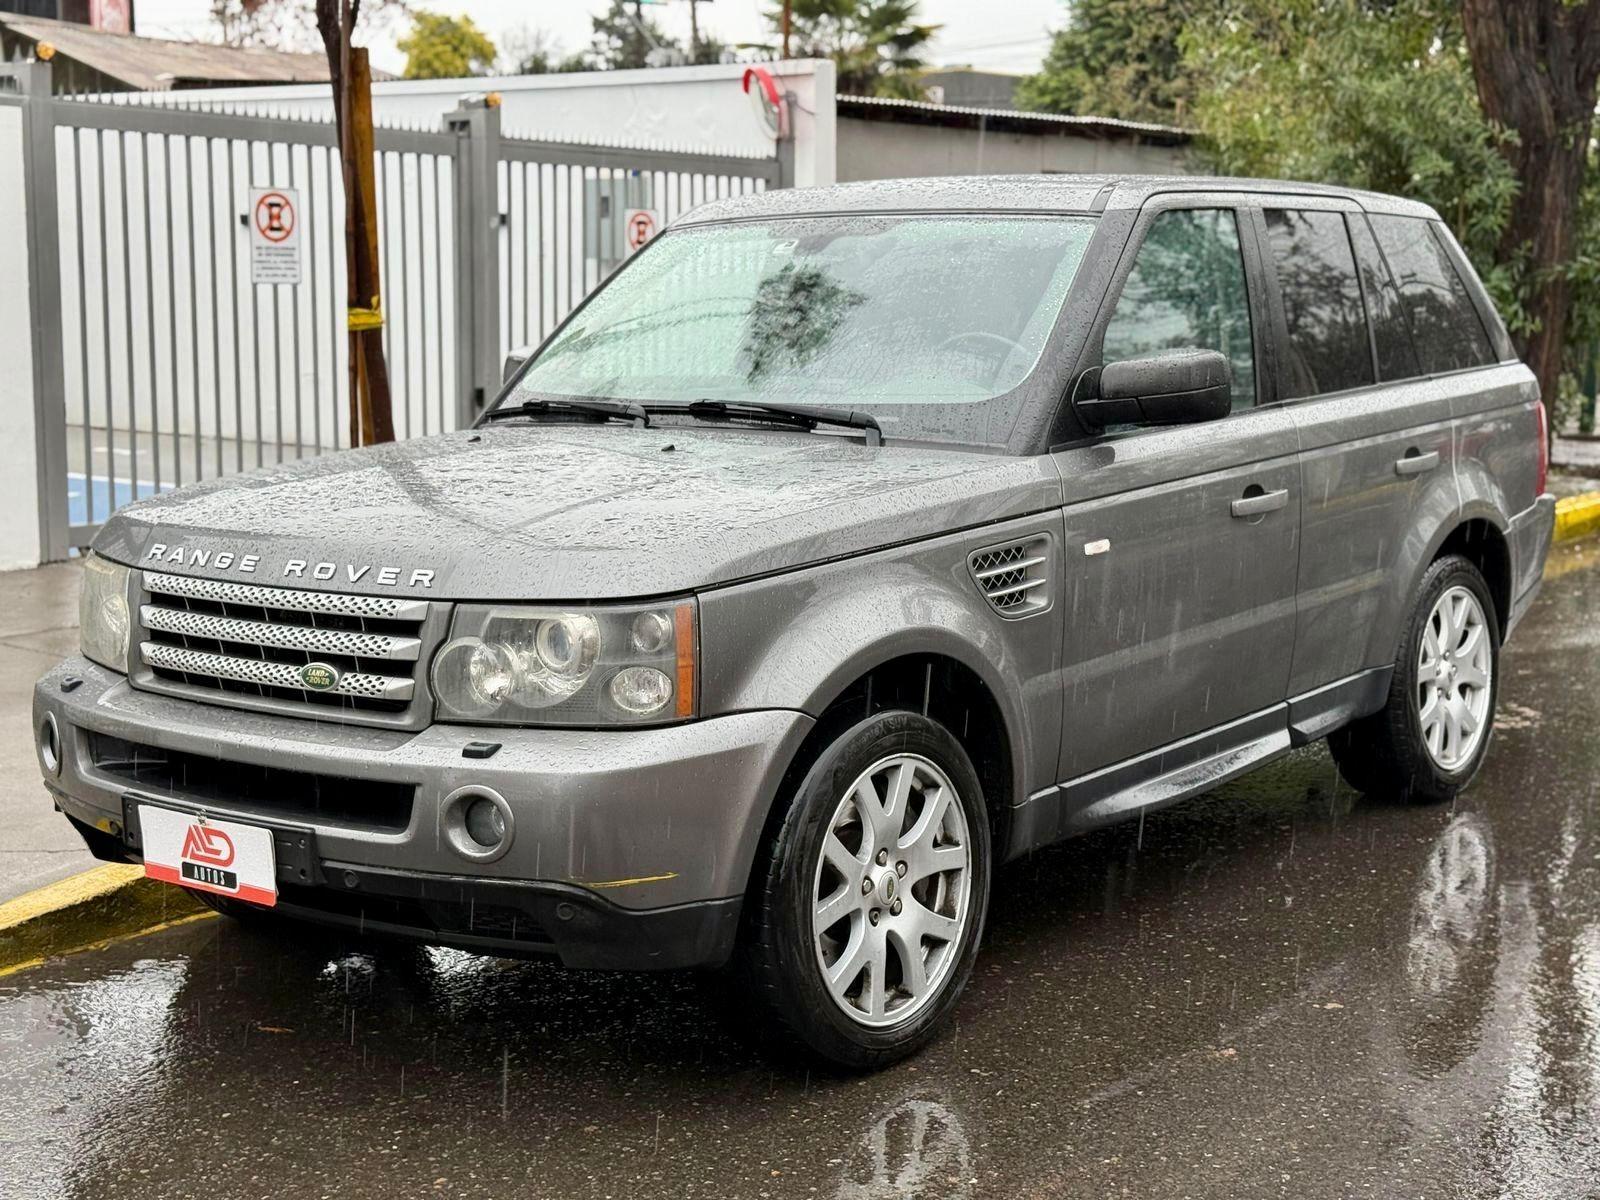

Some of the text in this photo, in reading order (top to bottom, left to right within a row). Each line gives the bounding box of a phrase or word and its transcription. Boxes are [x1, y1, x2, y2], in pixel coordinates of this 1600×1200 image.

[147, 542, 436, 588] RANGE ROVER
[308, 668, 326, 677] LAND
[194, 866, 226, 885] AUTOS
